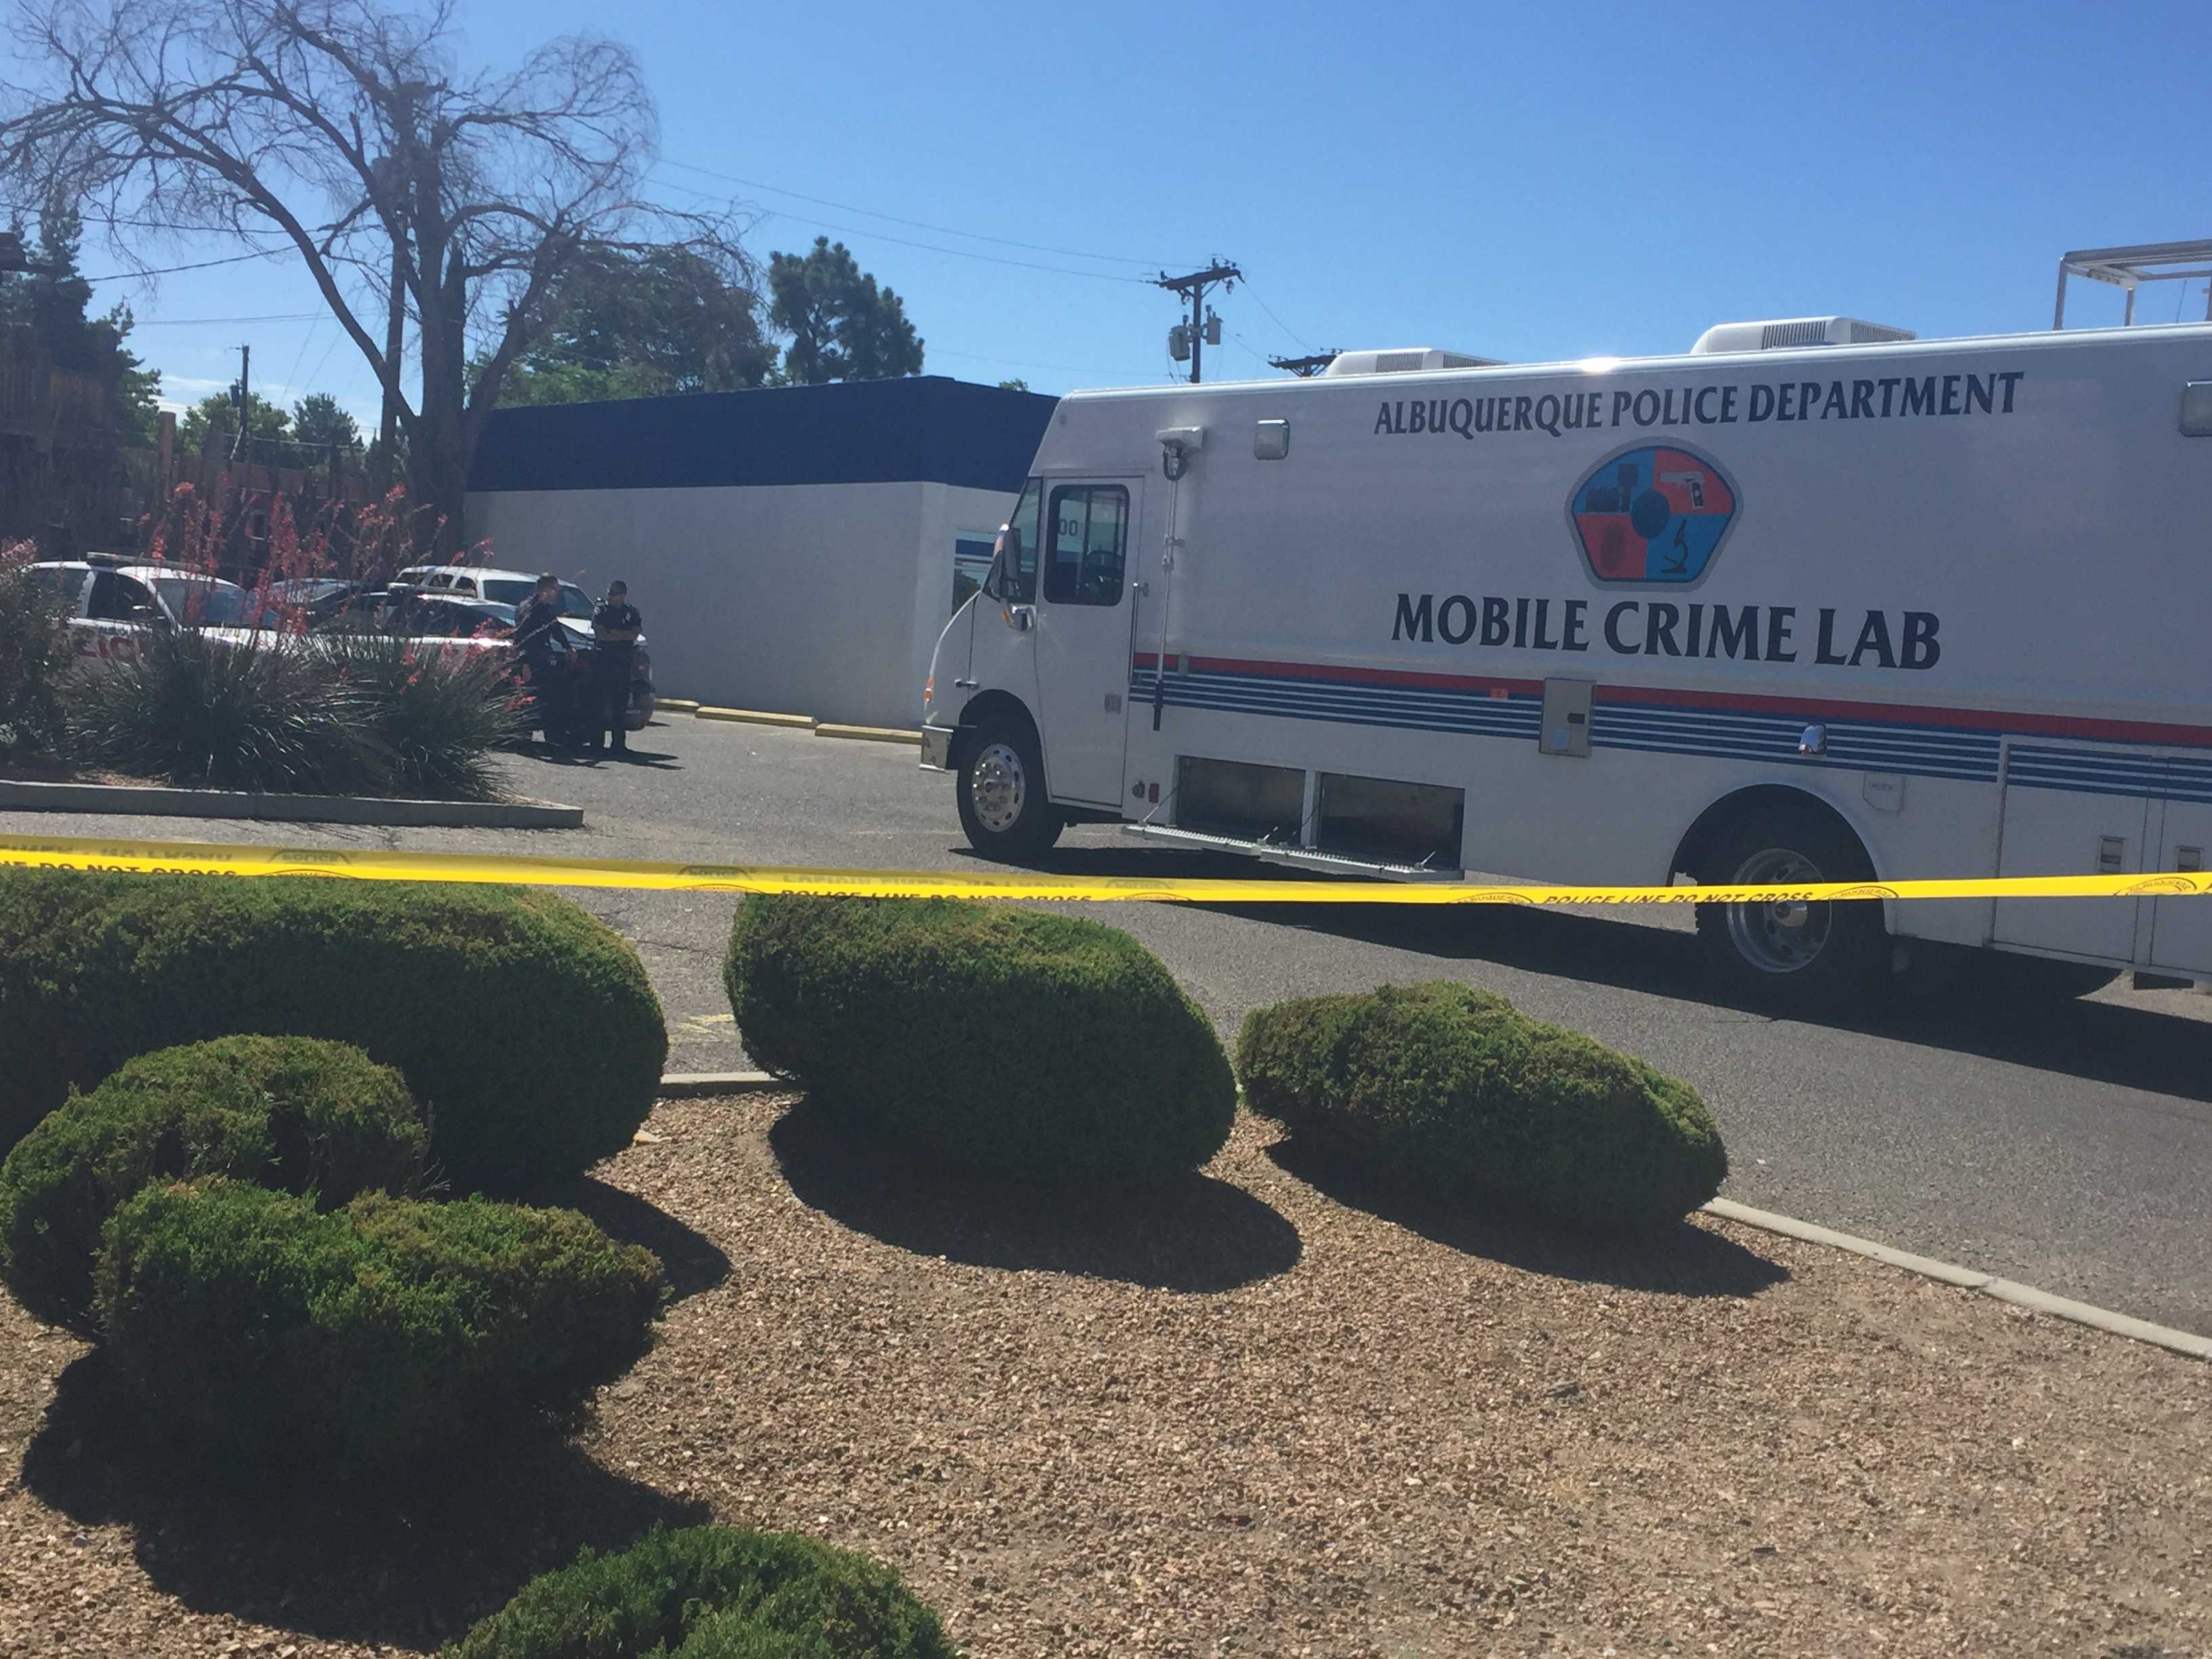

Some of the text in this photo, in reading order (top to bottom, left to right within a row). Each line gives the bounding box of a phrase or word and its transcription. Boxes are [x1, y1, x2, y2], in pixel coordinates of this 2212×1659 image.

[1374, 372, 2024, 440] ALBUQUERQUE POLICE DEPARTMENT
[1391, 593, 1942, 670] MOBILE CRIME LAB
